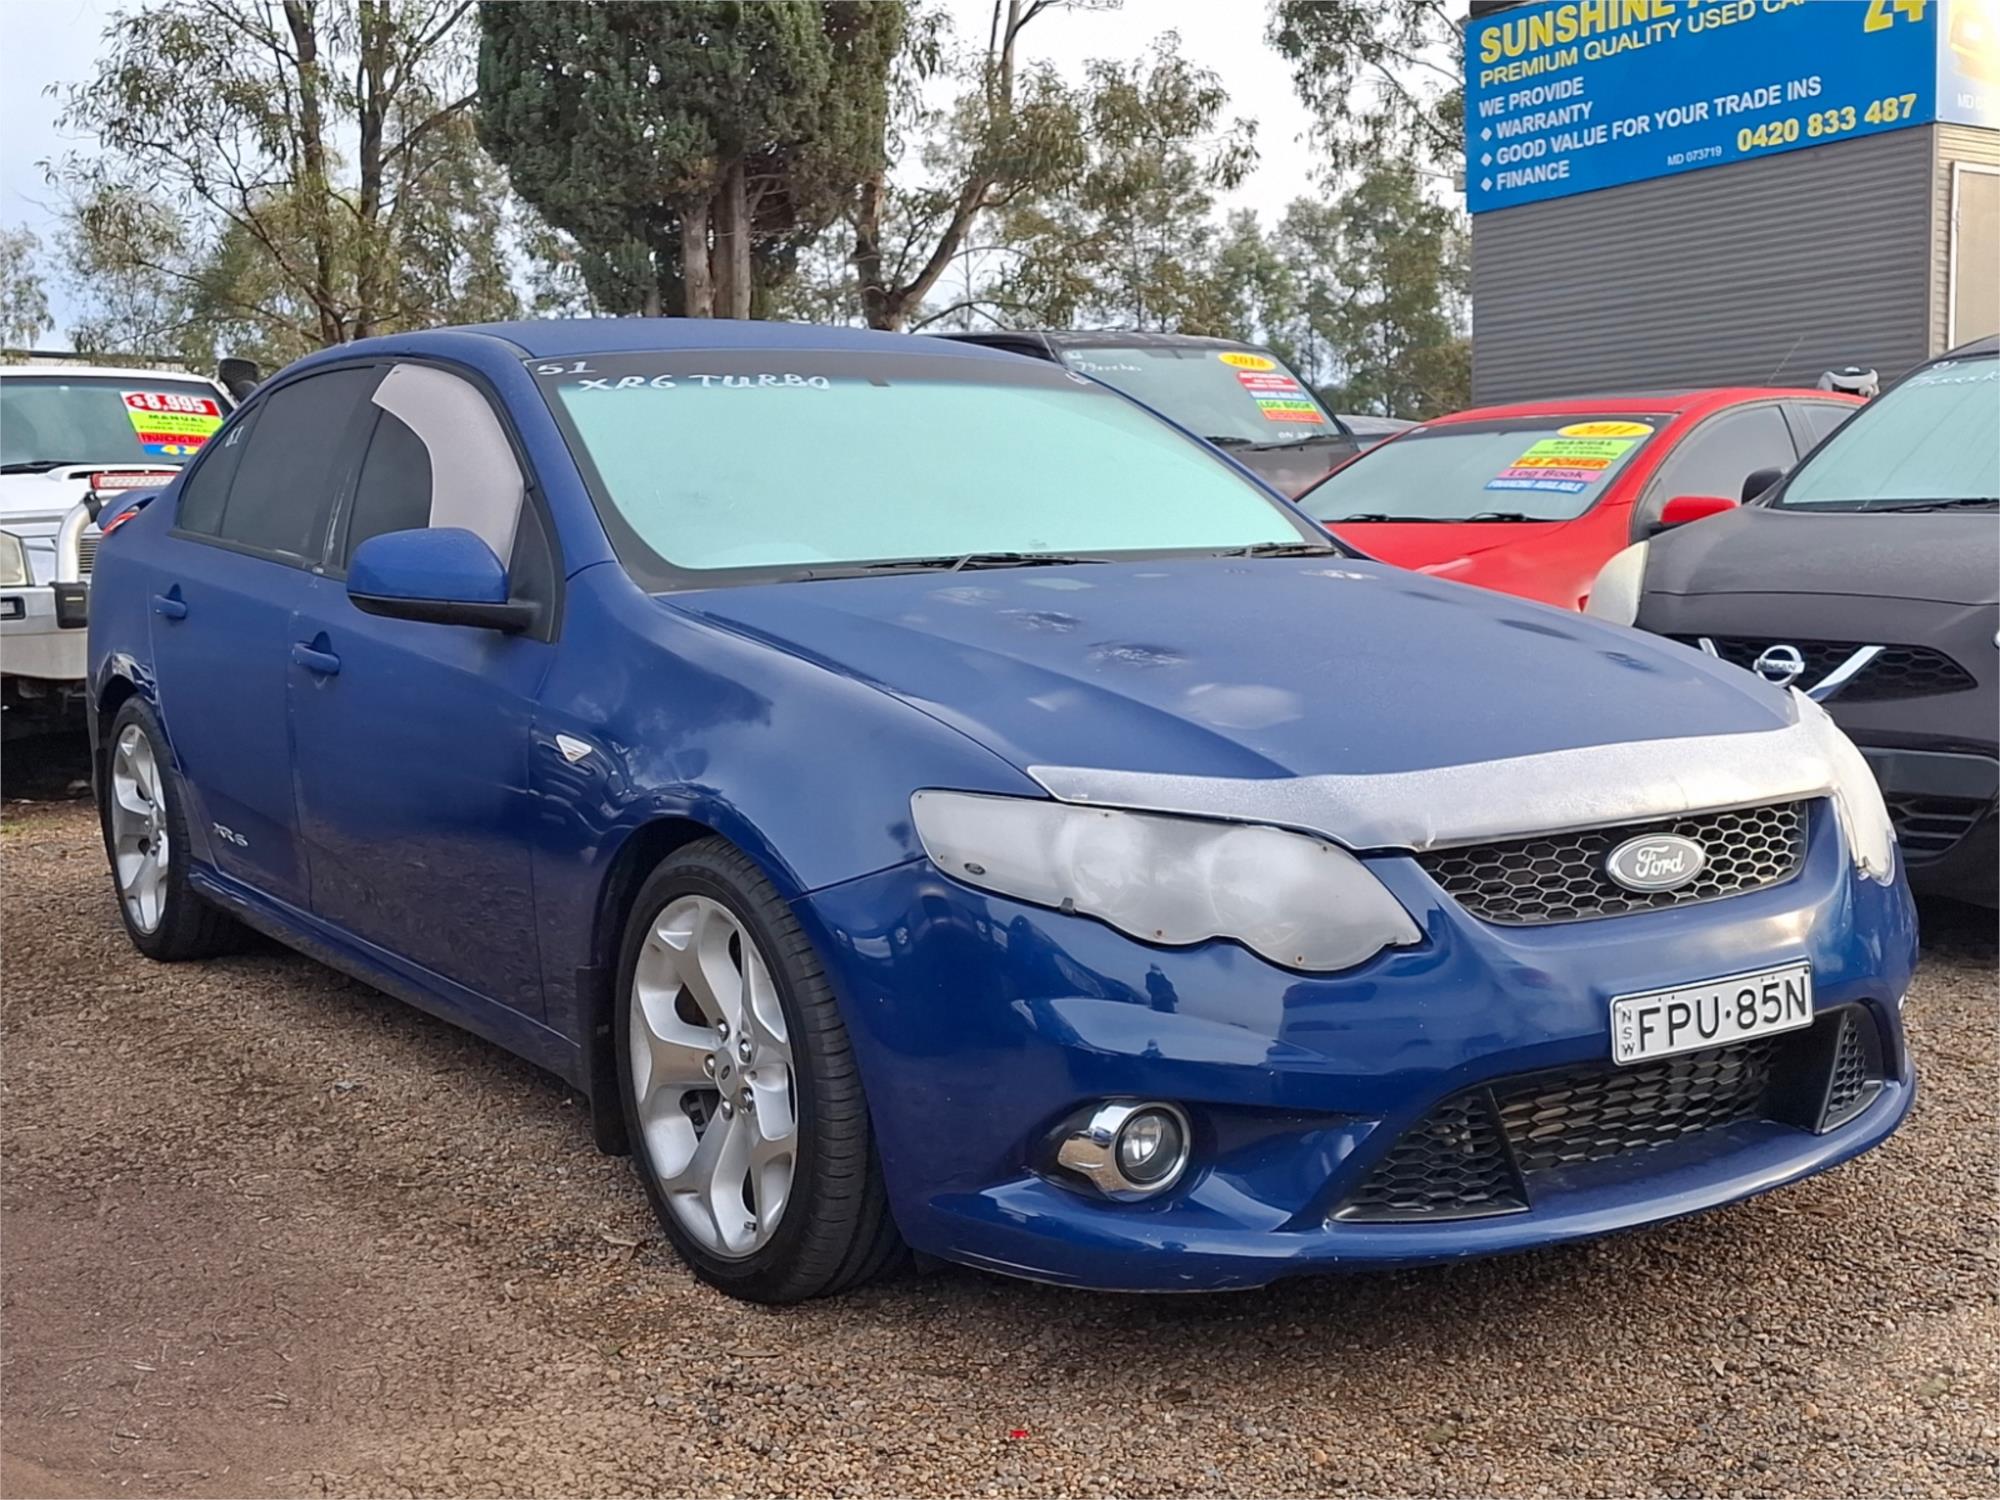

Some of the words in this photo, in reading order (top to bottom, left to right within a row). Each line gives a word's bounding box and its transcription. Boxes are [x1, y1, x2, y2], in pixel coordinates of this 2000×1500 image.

[1480, 46, 1579, 89] PREMIUM
[1584, 18, 1682, 61] QUALITY
[1688, 1, 1756, 33] USED
[1478, 96, 1505, 118] WE
[1509, 76, 1584, 111] PROVIDE
[1496, 139, 1547, 165] GOOD
[1550, 124, 1608, 153] VALUE
[1612, 115, 1650, 140] FOR
[1654, 101, 1709, 130] YOUR
[1713, 84, 1782, 117] TRADE
[1787, 75, 1822, 101] INS
[1496, 101, 1593, 140] WARRANTY
[1737, 117, 1800, 152] 0420
[1807, 106, 1857, 138] 833
[1864, 93, 1918, 125] 487
[1667, 153, 1684, 167] MD
[1685, 145, 1723, 164] 073719
[1496, 160, 1570, 191] FINANCE
[577, 373, 678, 392] XR6
[688, 373, 831, 391] TURBO
[1508, 469, 1539, 479] Log
[1542, 470, 1584, 479] Book
[213, 822, 248, 847] XR6
[1635, 845, 1686, 878] Ford
